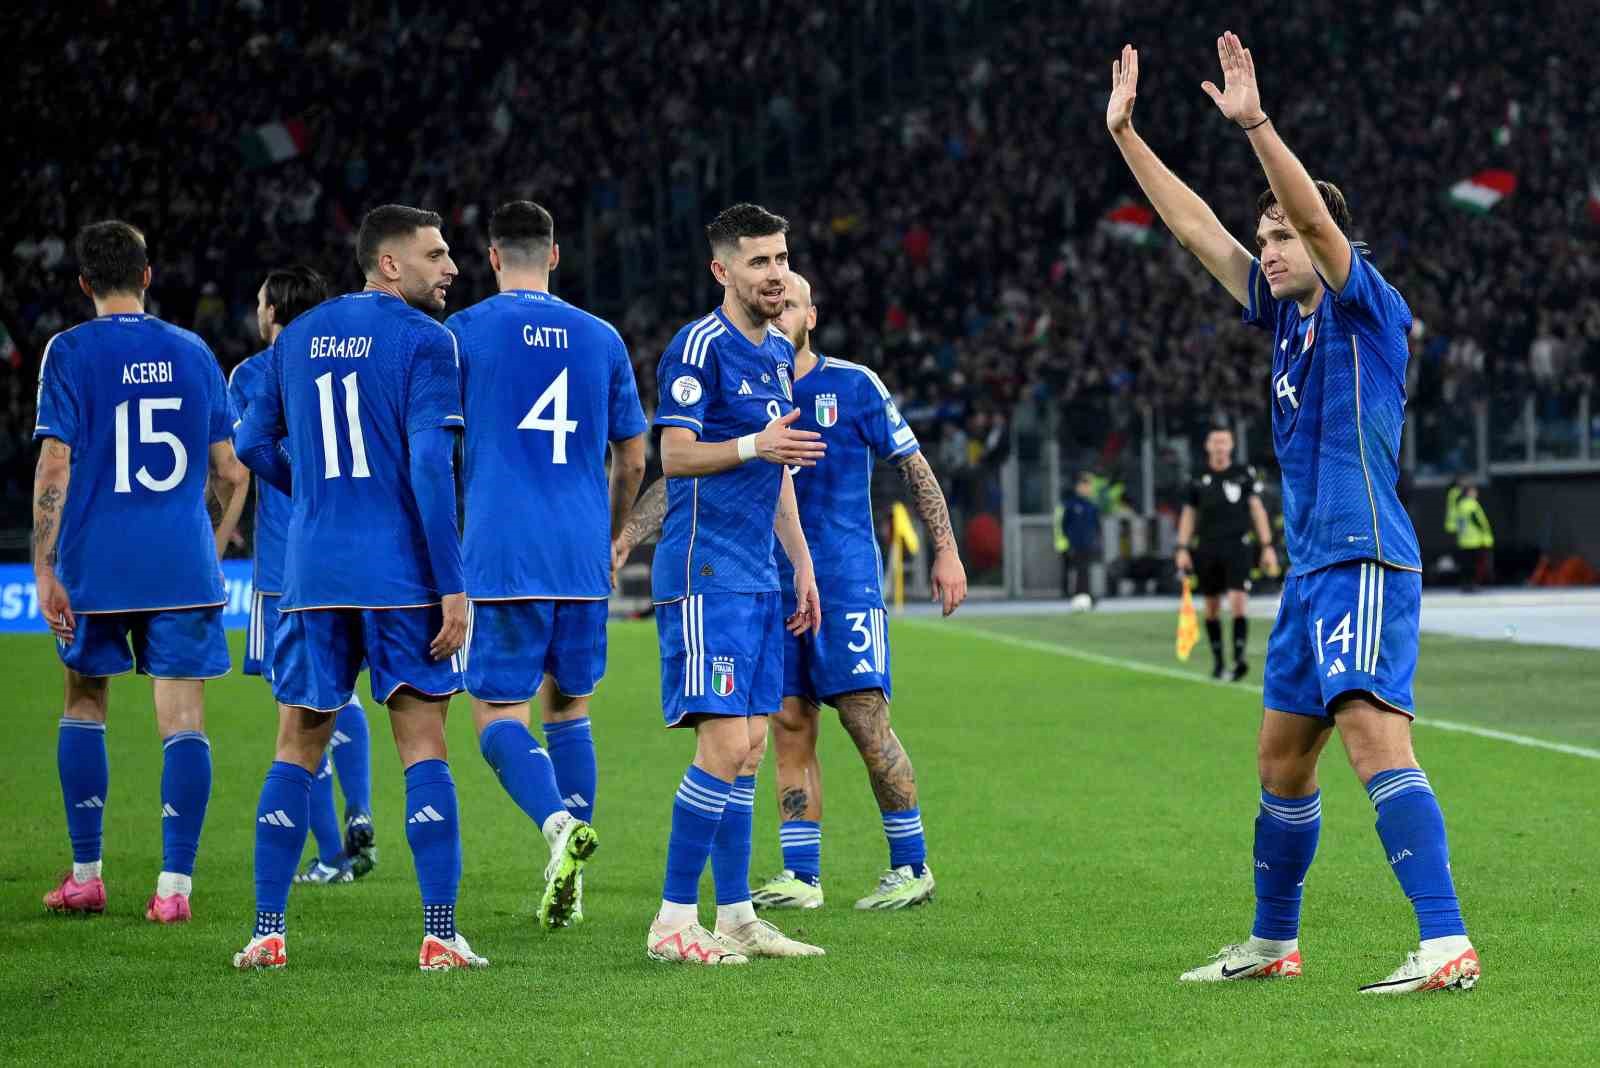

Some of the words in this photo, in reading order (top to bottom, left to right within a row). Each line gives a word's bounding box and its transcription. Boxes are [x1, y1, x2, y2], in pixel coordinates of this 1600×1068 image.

[310, 336, 372, 359] BERARDI
[523, 324, 569, 349] GATTI
[122, 361, 173, 384] ACERBI
[315, 371, 371, 480] 11
[517, 367, 579, 465] 4
[114, 397, 188, 493] 15
[845, 612, 872, 653] 3
[1315, 611, 1355, 665] 14
[1390, 848, 1414, 865] LIA
